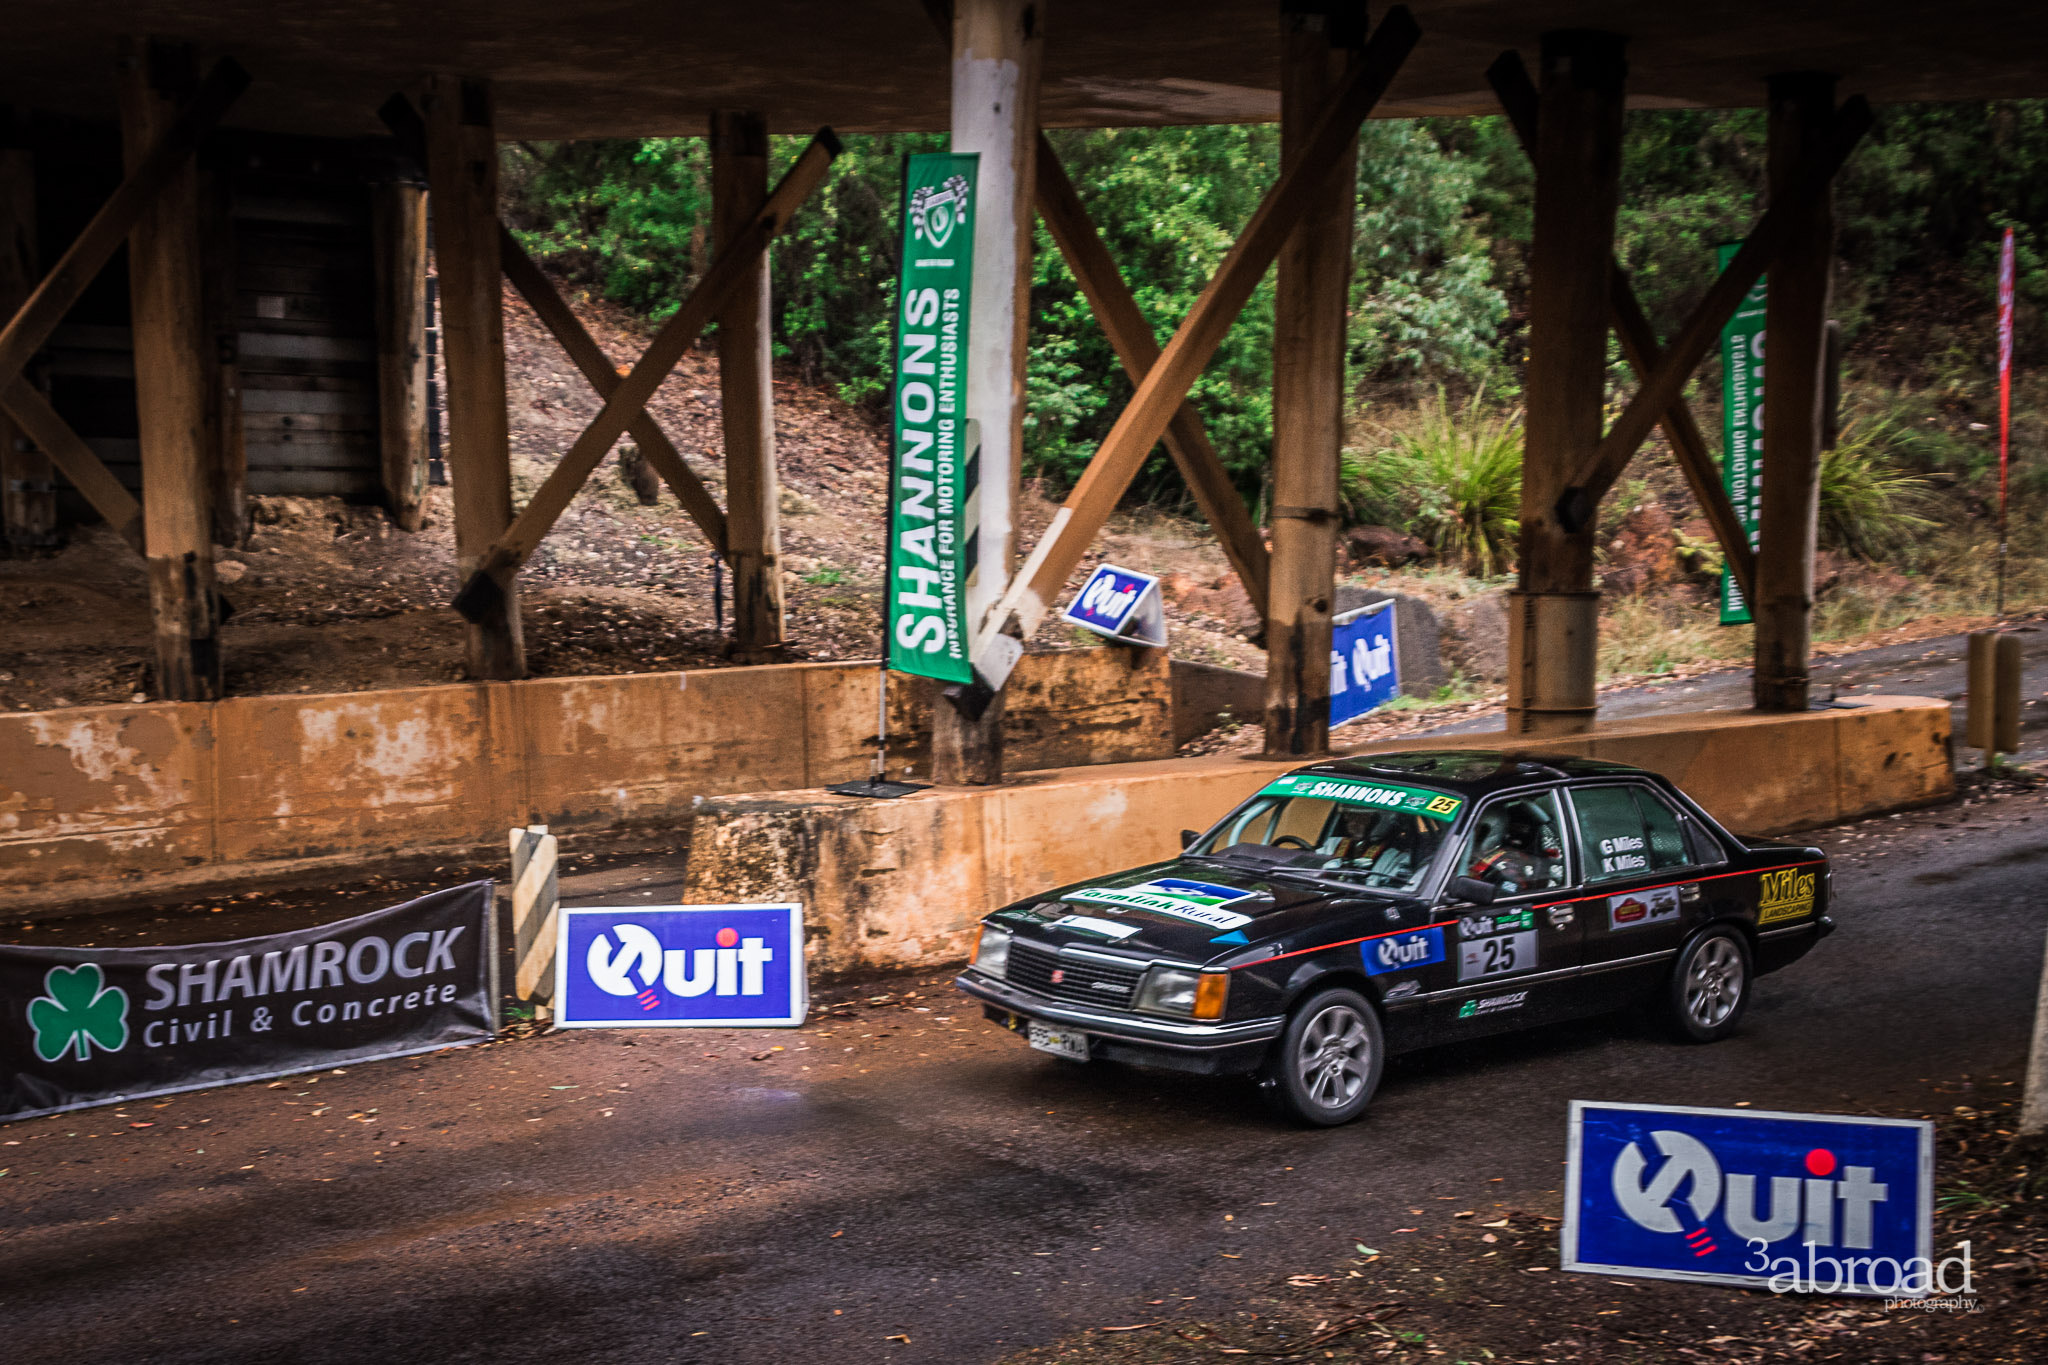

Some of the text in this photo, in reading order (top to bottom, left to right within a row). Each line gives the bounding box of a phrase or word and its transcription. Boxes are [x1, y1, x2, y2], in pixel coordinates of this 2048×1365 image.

[938, 288, 960, 413] ENTHUSIASTS
[895, 288, 947, 654] SHANNONS
[937, 418, 955, 513] MOTORING
[938, 519, 955, 551] FOR
[1081, 574, 1137, 618] Quit
[1308, 781, 1407, 806] SHANNONS
[1432, 797, 1454, 812] 25
[1600, 836, 1644, 856] G Miles
[1603, 854, 1646, 873] K Miles
[1760, 868, 1815, 905] Miles
[1173, 905, 1237, 924] Rural
[1460, 916, 1494, 938] Quit
[145, 925, 466, 1010] SHAMROCK
[586, 923, 774, 1011] Quit
[1378, 935, 1430, 968] Quit
[1483, 936, 1516, 974] 25
[144, 982, 457, 1049] Civil & Concrete
[1612, 1130, 1888, 1257] Quit
